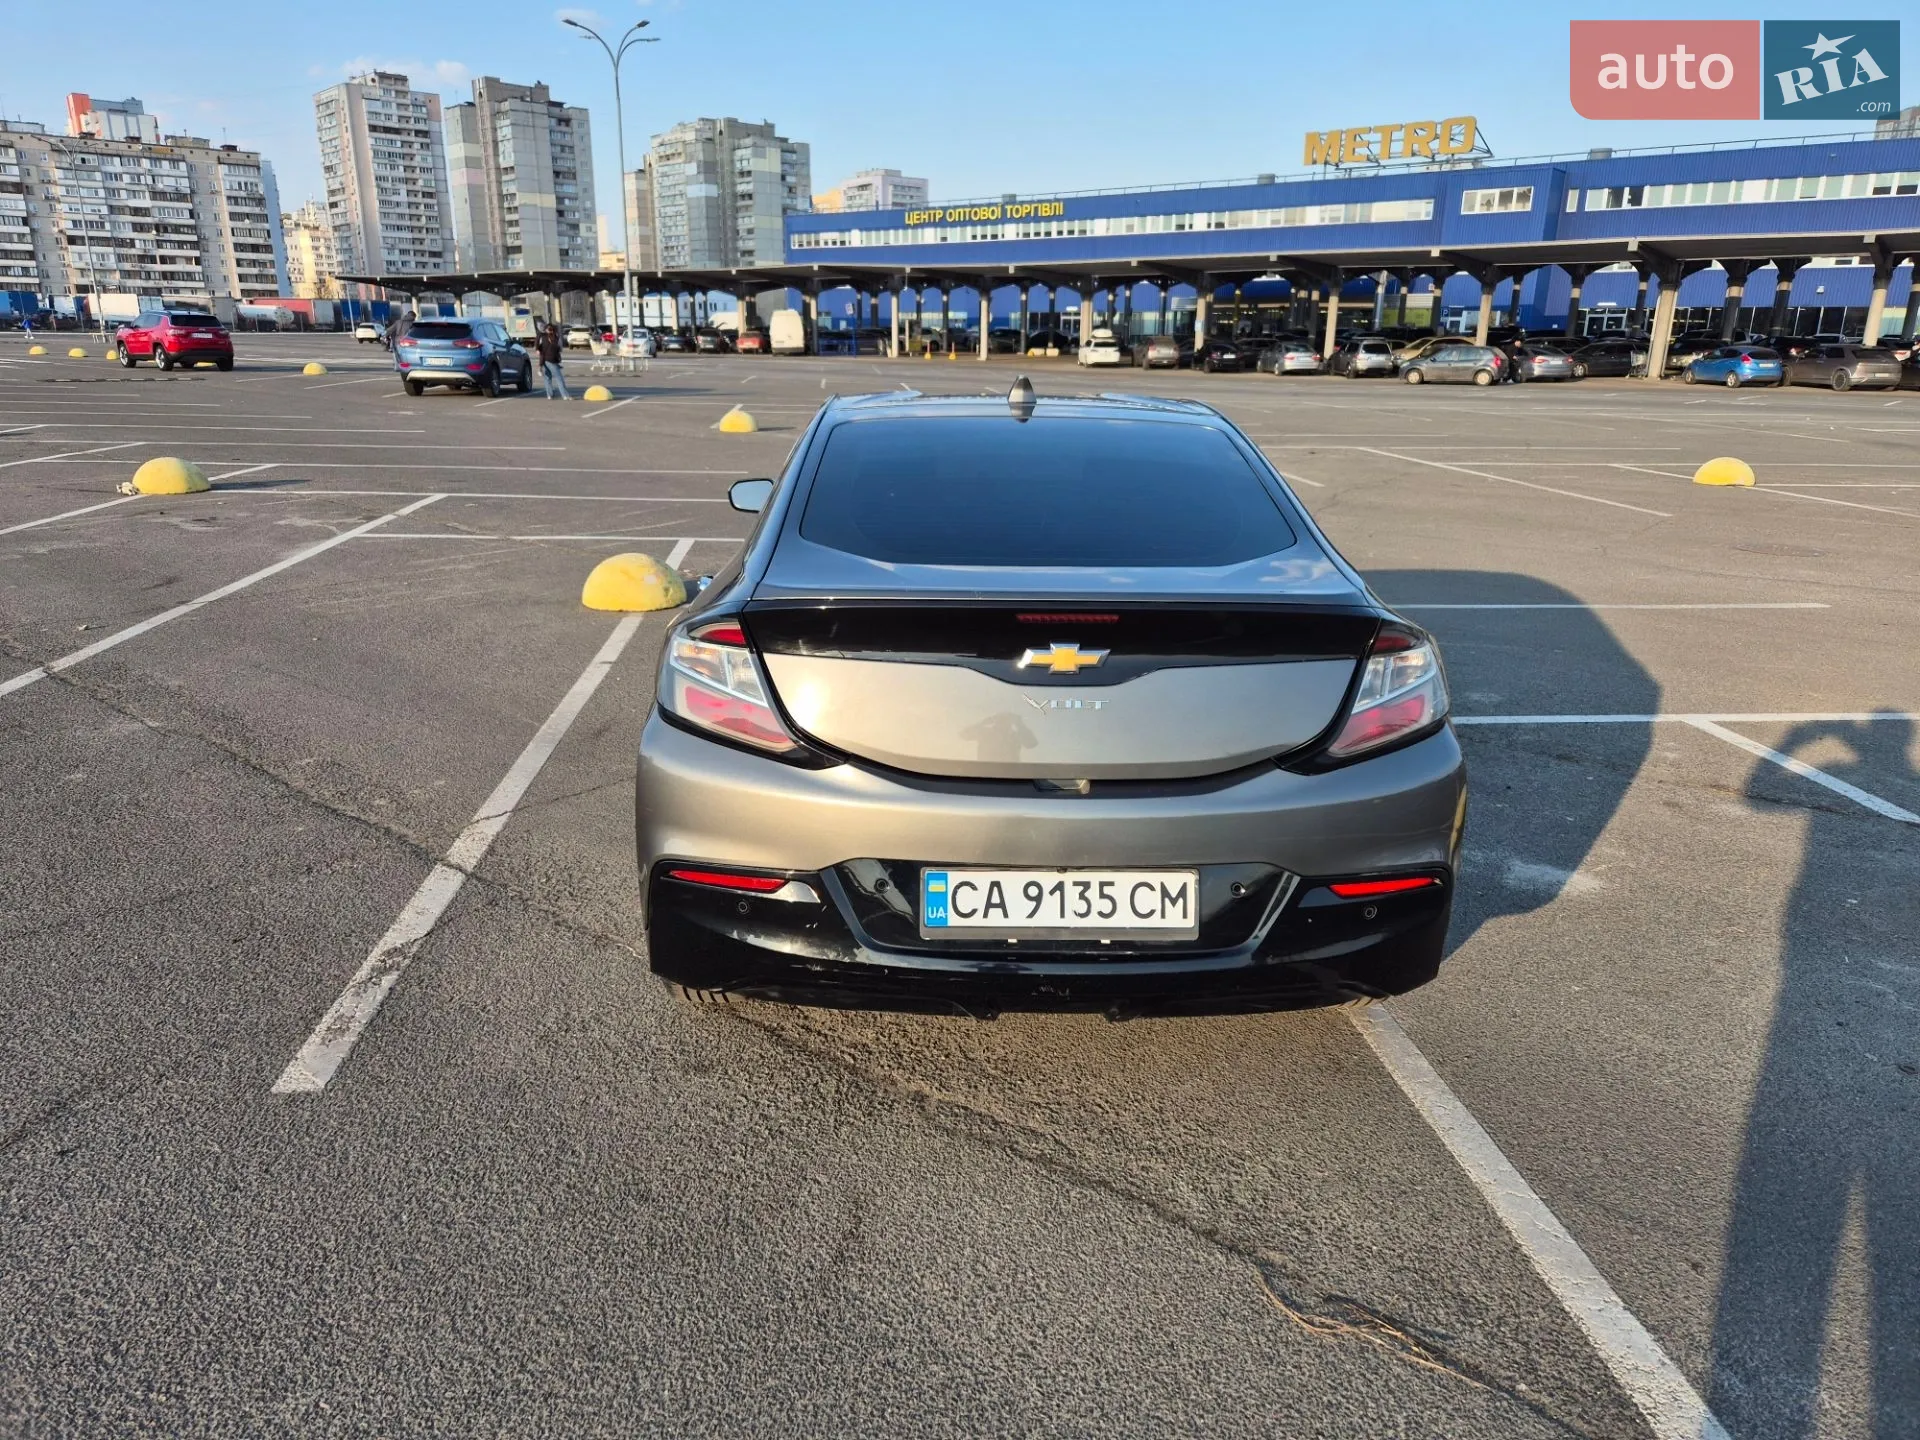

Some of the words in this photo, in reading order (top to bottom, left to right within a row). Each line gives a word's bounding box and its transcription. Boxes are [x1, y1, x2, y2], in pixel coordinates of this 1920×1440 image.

[1304, 116, 1477, 166] METRO
[904, 209, 944, 226] ЦЕНТР
[945, 203, 1002, 222] ОПТОВОЇ
[1004, 201, 1064, 219] ТОРГІВЛІ
[928, 906, 946, 919] UA
[951, 880, 1009, 919] CA
[1022, 880, 1118, 919] 9135
[1129, 880, 1189, 919] CM
